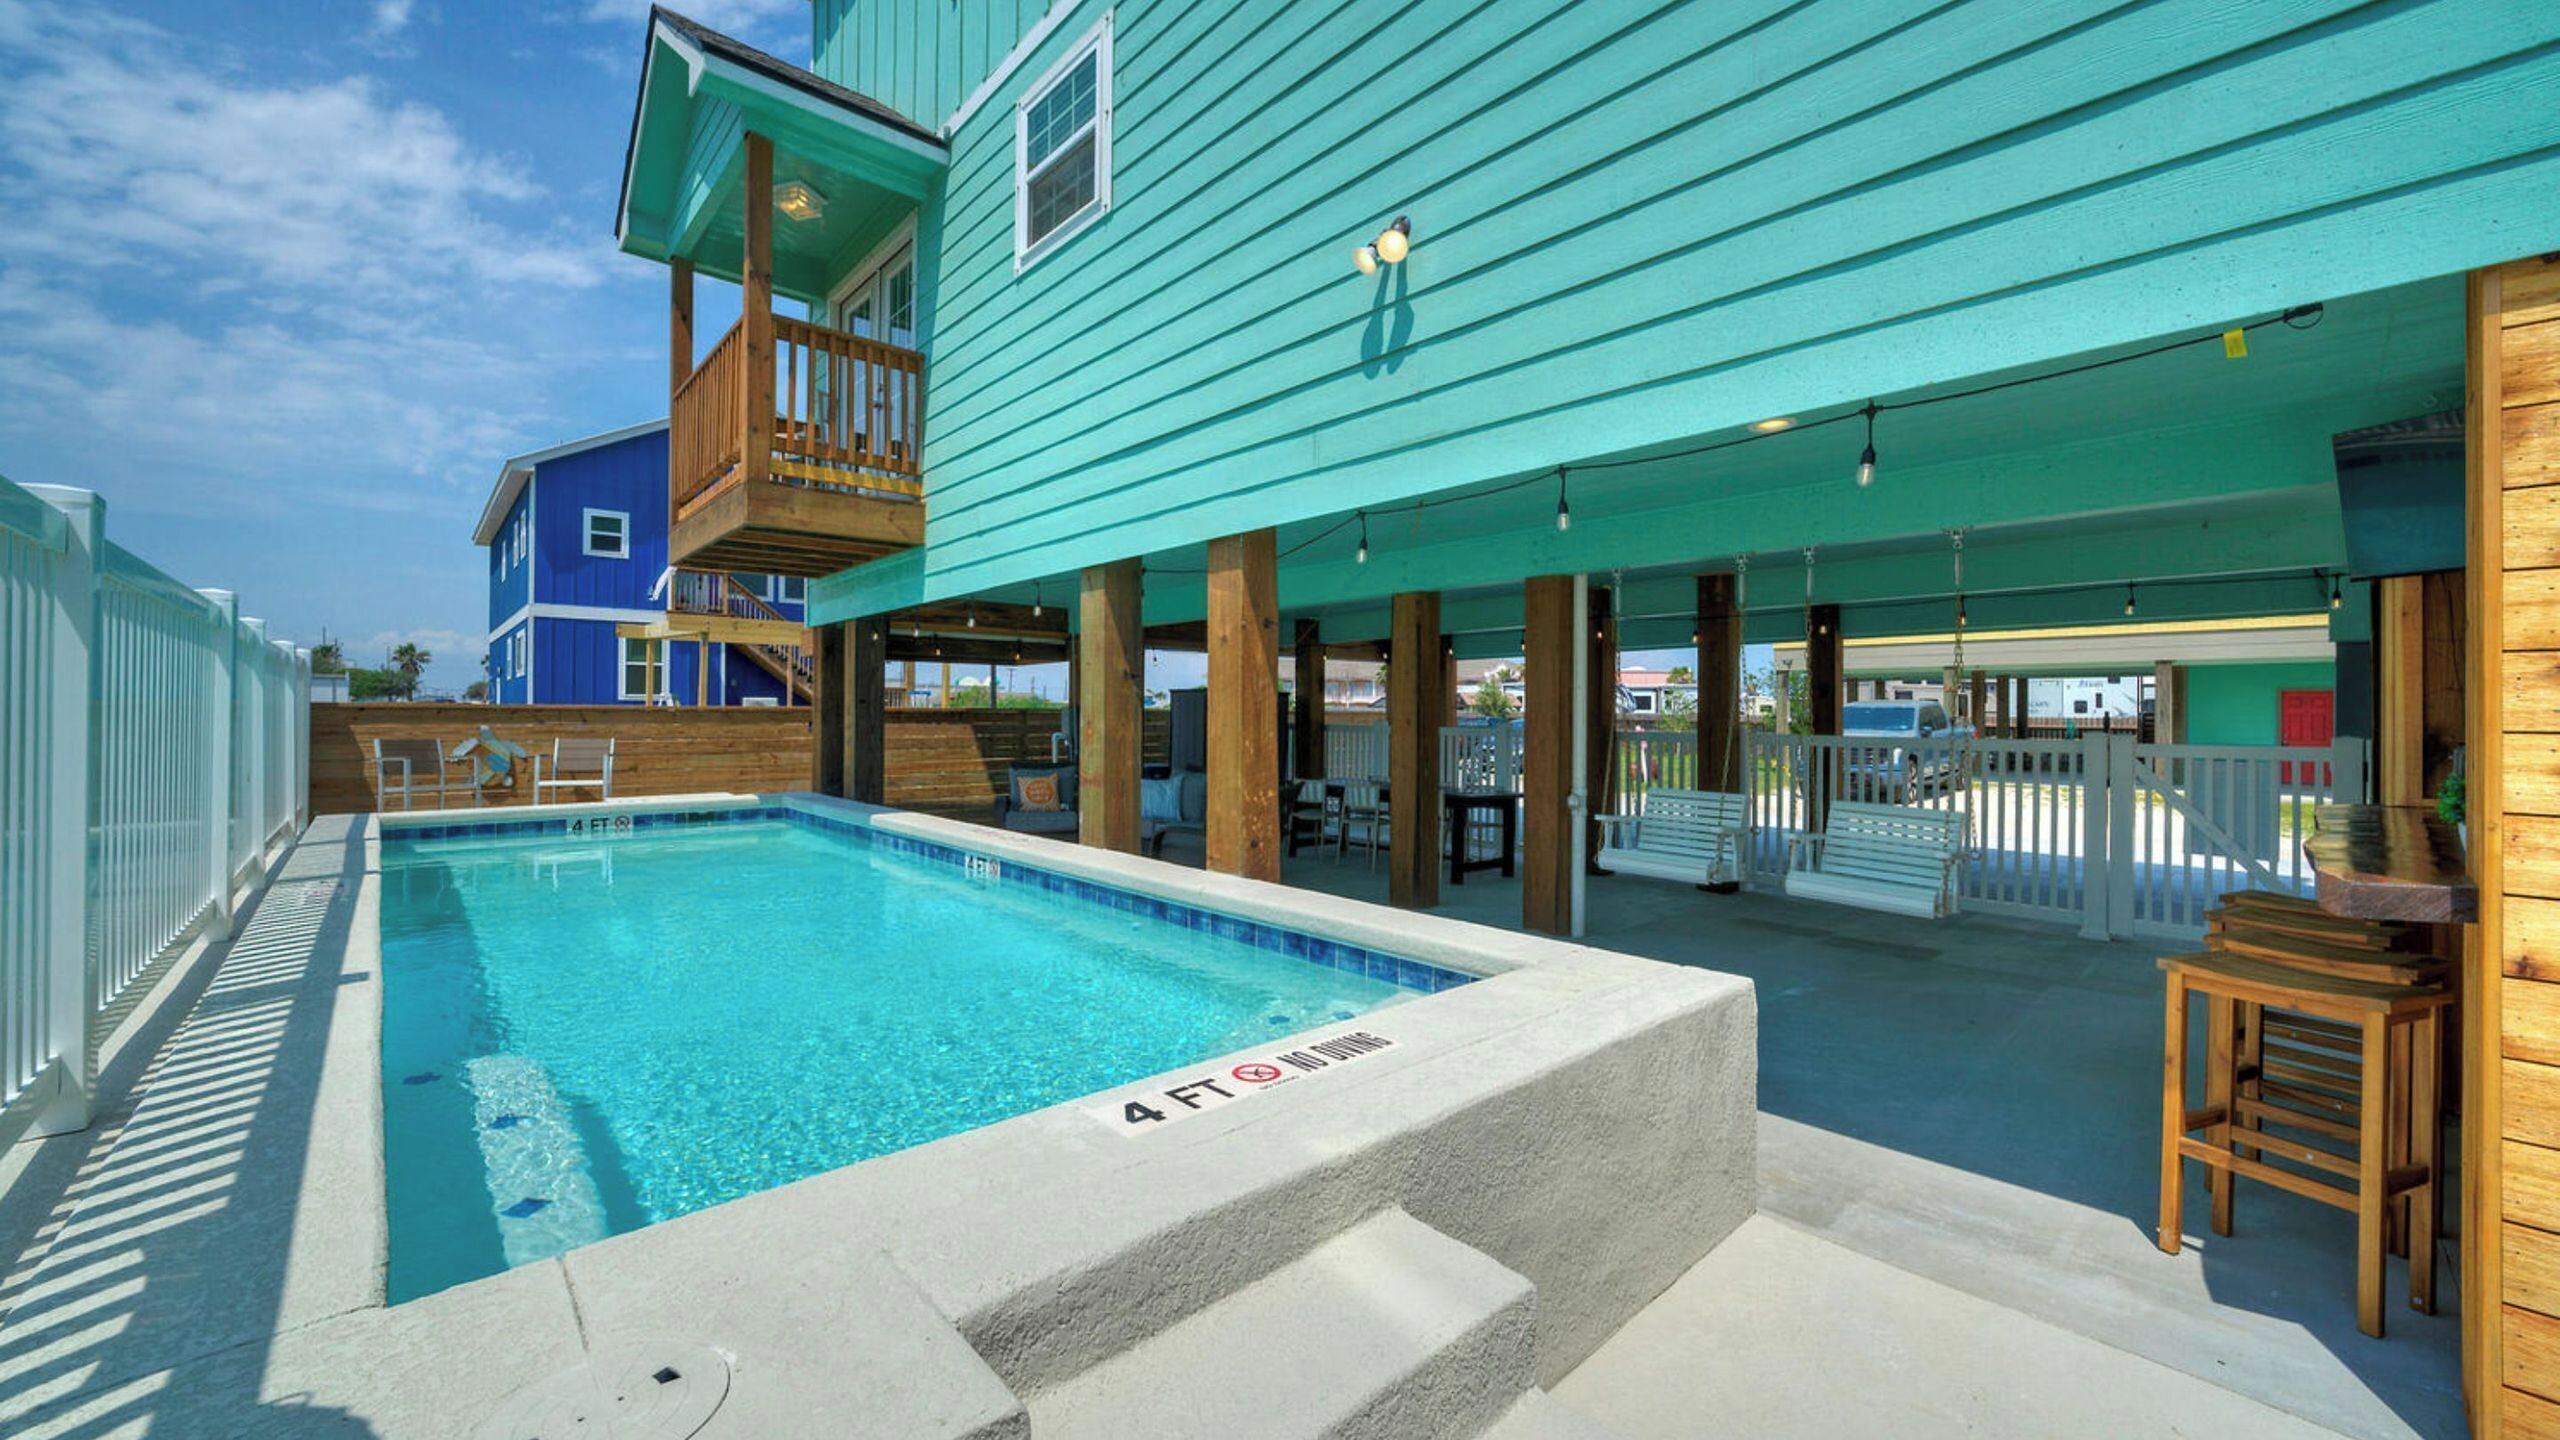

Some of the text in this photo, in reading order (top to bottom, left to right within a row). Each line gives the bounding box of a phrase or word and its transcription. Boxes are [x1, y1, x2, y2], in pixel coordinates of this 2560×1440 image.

[572, 817, 610, 832] 4 FT
[1124, 1101, 1167, 1124] 4
[1164, 1078, 1236, 1109] FT
[1276, 1050, 1329, 1073] NO
[1309, 1032, 1393, 1061] DIVING
